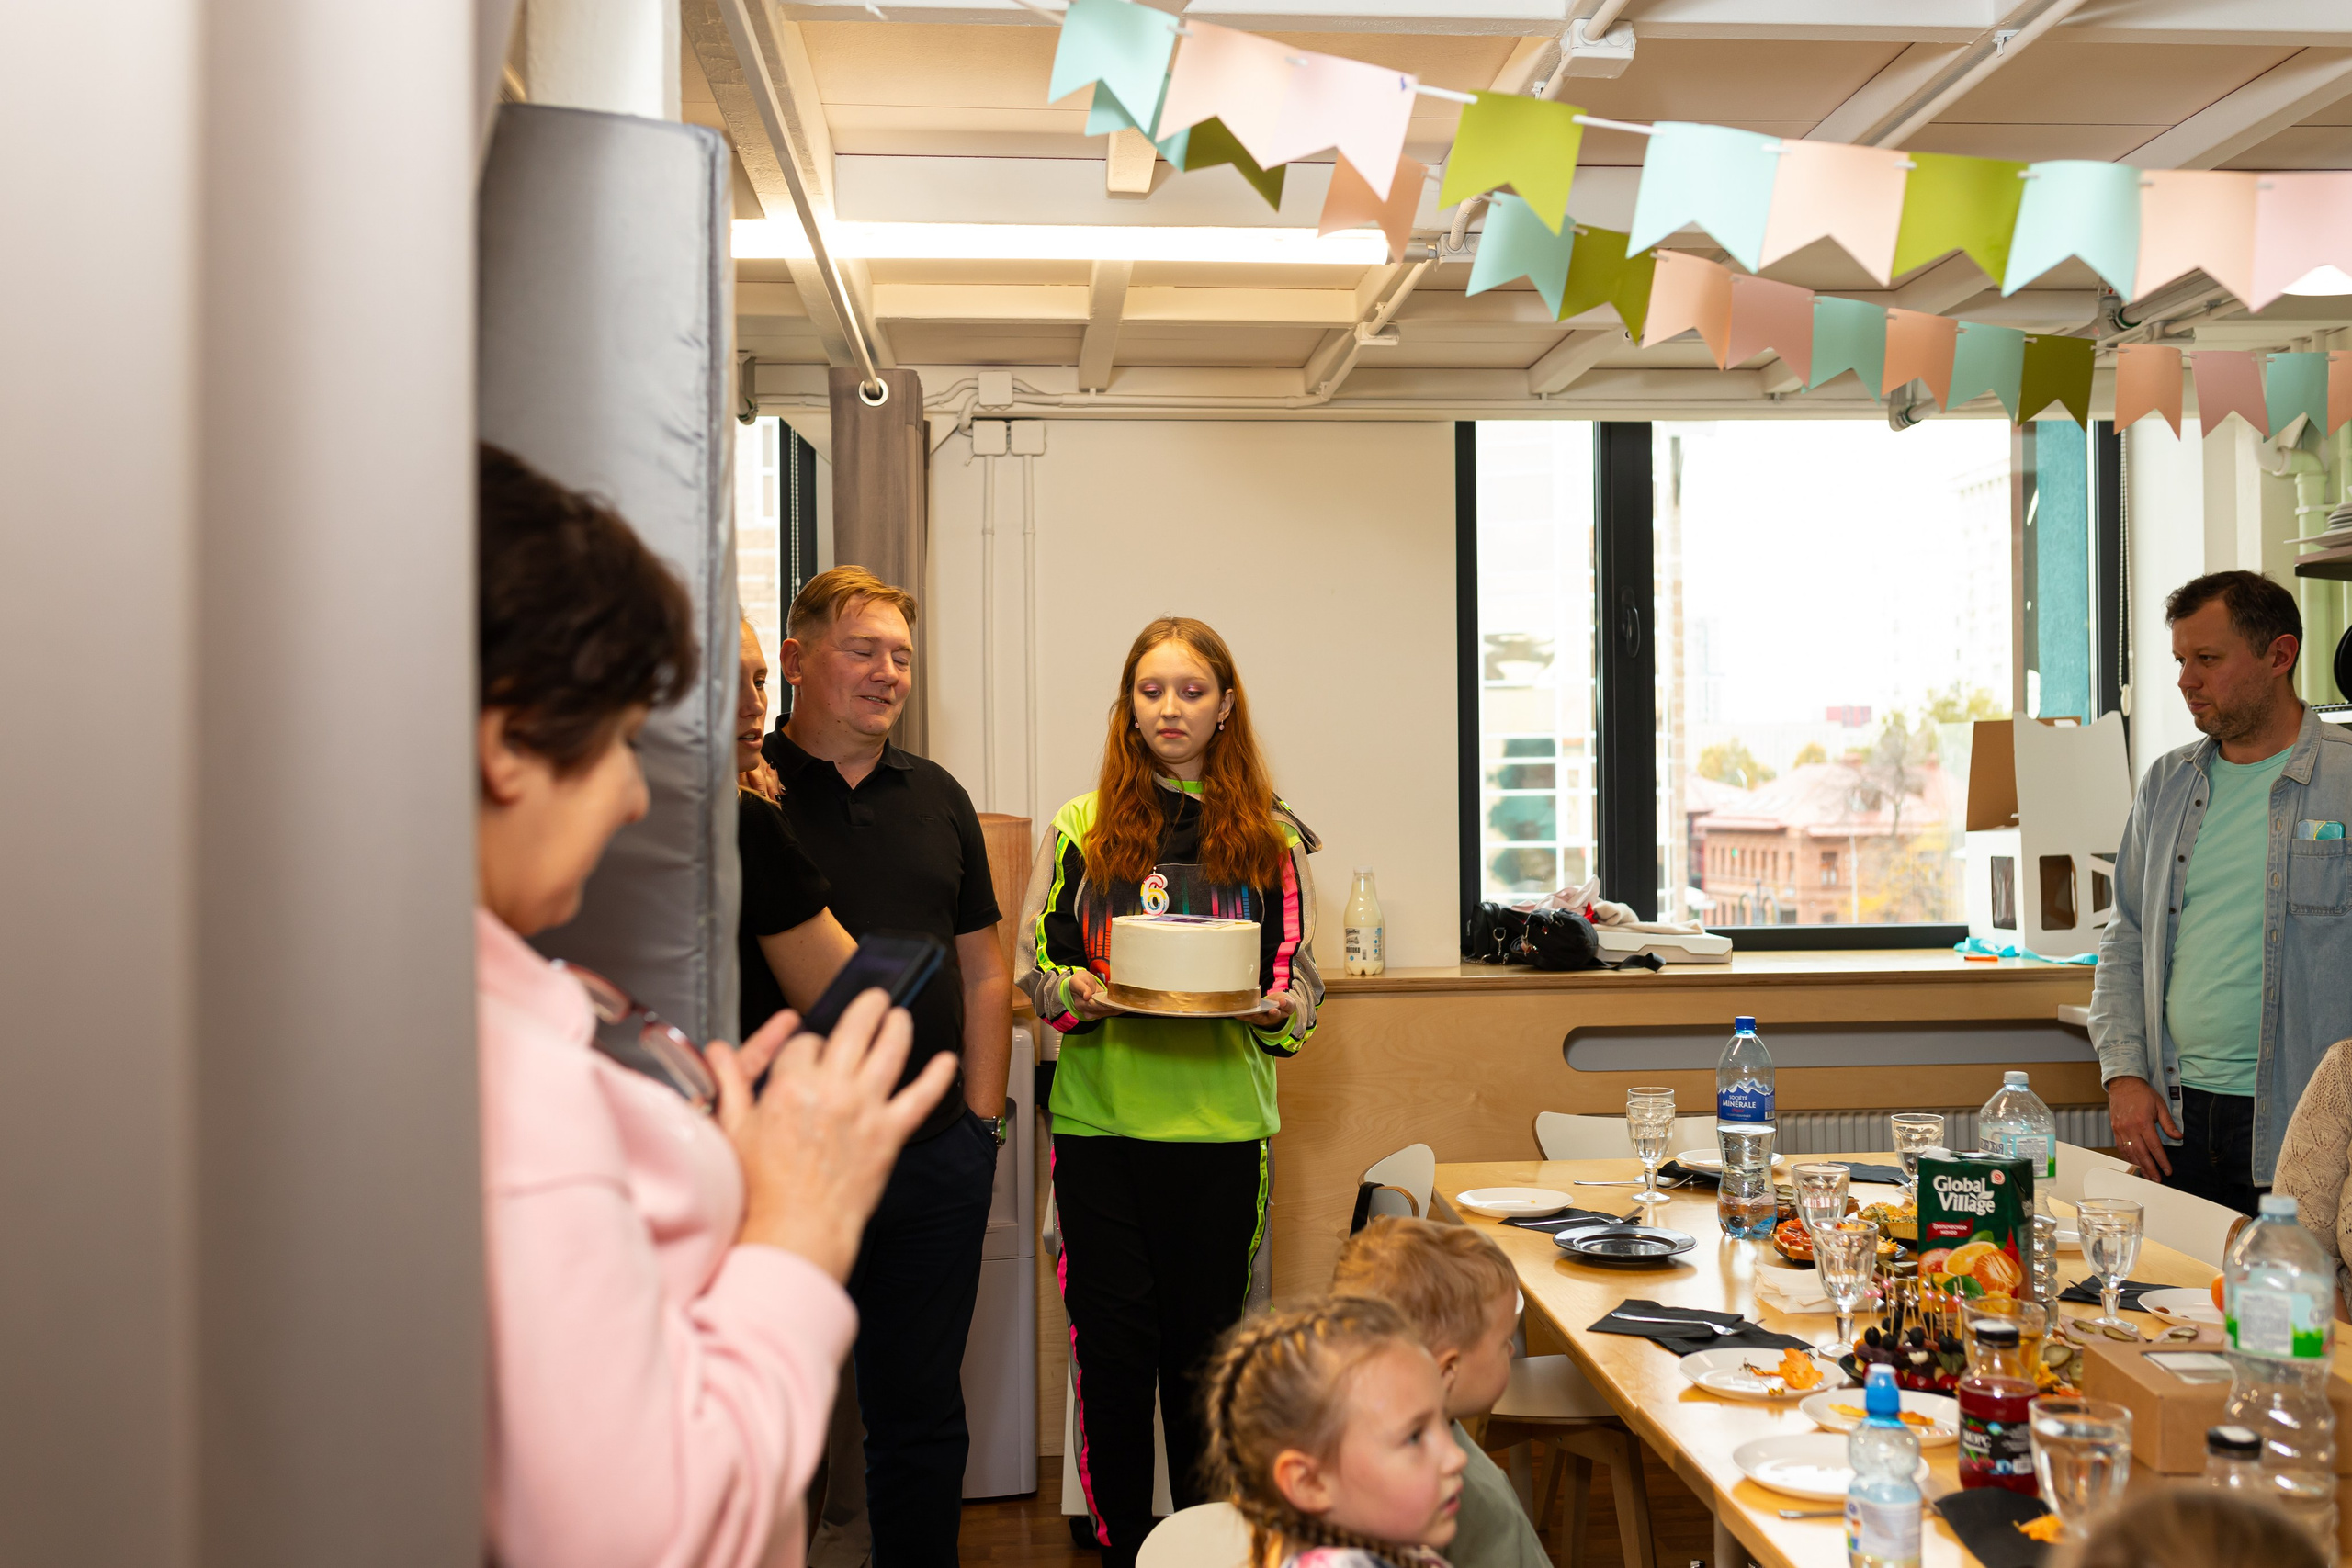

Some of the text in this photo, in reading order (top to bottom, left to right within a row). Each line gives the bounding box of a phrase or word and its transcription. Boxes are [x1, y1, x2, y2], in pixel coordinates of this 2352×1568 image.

[1140, 873, 1170, 916] 6
[1722, 1099, 1756, 1109] MINÉRALE
[1933, 1175, 1986, 1193] Global
[1938, 1192, 1996, 1216] Village
